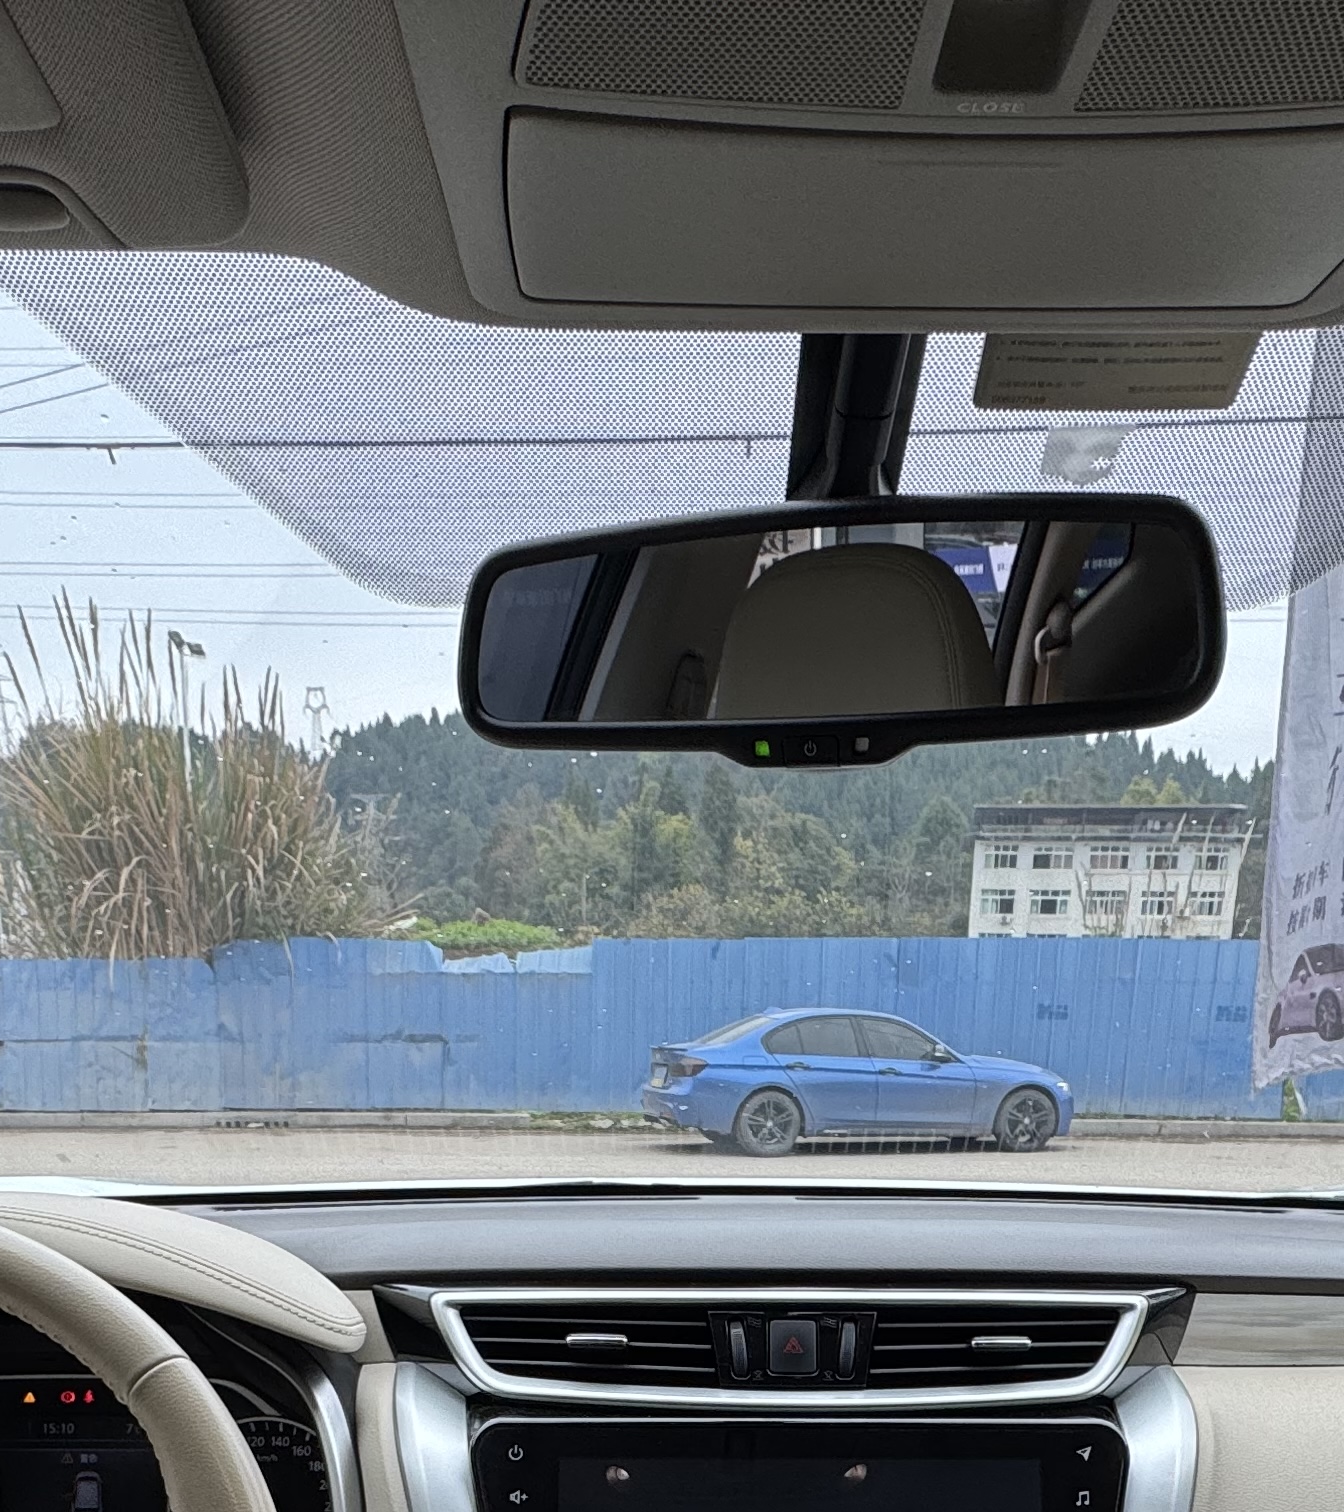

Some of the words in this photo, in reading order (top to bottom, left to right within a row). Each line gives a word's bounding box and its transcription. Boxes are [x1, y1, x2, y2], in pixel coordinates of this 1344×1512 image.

[43, 1423, 75, 1435] 15:10
[271, 1436, 290, 1447] 140
[292, 1445, 311, 1457] 160
